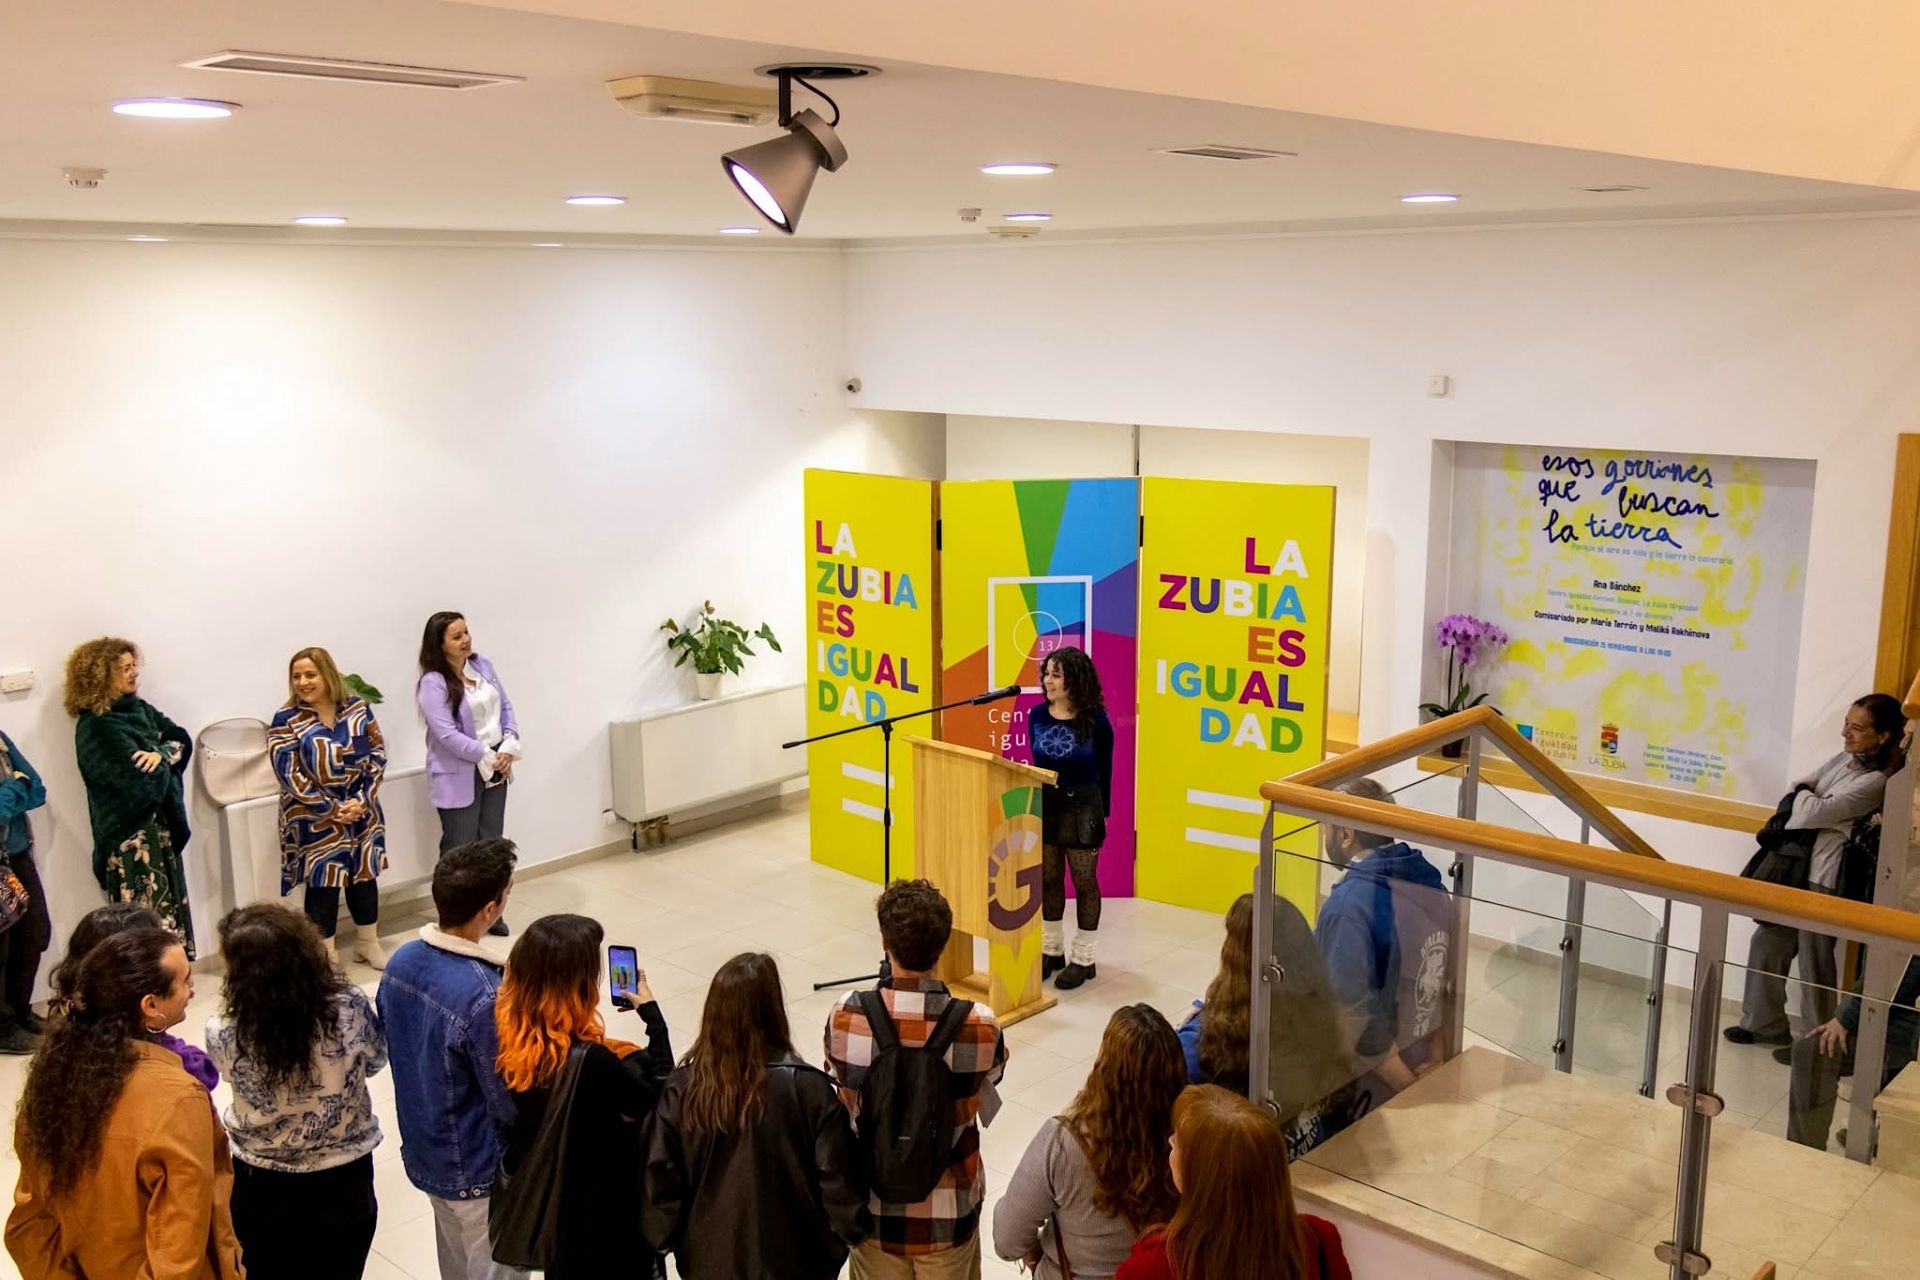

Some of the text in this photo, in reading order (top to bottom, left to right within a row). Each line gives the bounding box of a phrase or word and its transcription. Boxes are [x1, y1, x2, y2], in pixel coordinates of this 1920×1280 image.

[1542, 454, 1714, 496] esos gorriones
[1538, 478, 1720, 519] que buscan
[815, 520, 857, 559] LA
[1542, 508, 1683, 549] la tierra
[1244, 537, 1309, 579] LA
[816, 560, 918, 610] ZUBIA
[1158, 573, 1307, 623] ZUBIA
[1593, 579, 1641, 593] Ana Sánchez
[817, 600, 855, 638] ES
[1534, 610, 1575, 623] Comisariado
[1576, 616, 1590, 625] por
[1590, 616, 1612, 627] María
[1613, 619, 1638, 630] Terrón
[816, 639, 919, 694] IGUAL
[1039, 640, 1054, 651] 13
[1247, 625, 1306, 667] ES
[818, 679, 887, 723] DAD
[1156, 659, 1305, 712] IGUAL
[1200, 707, 1303, 754] DAD
